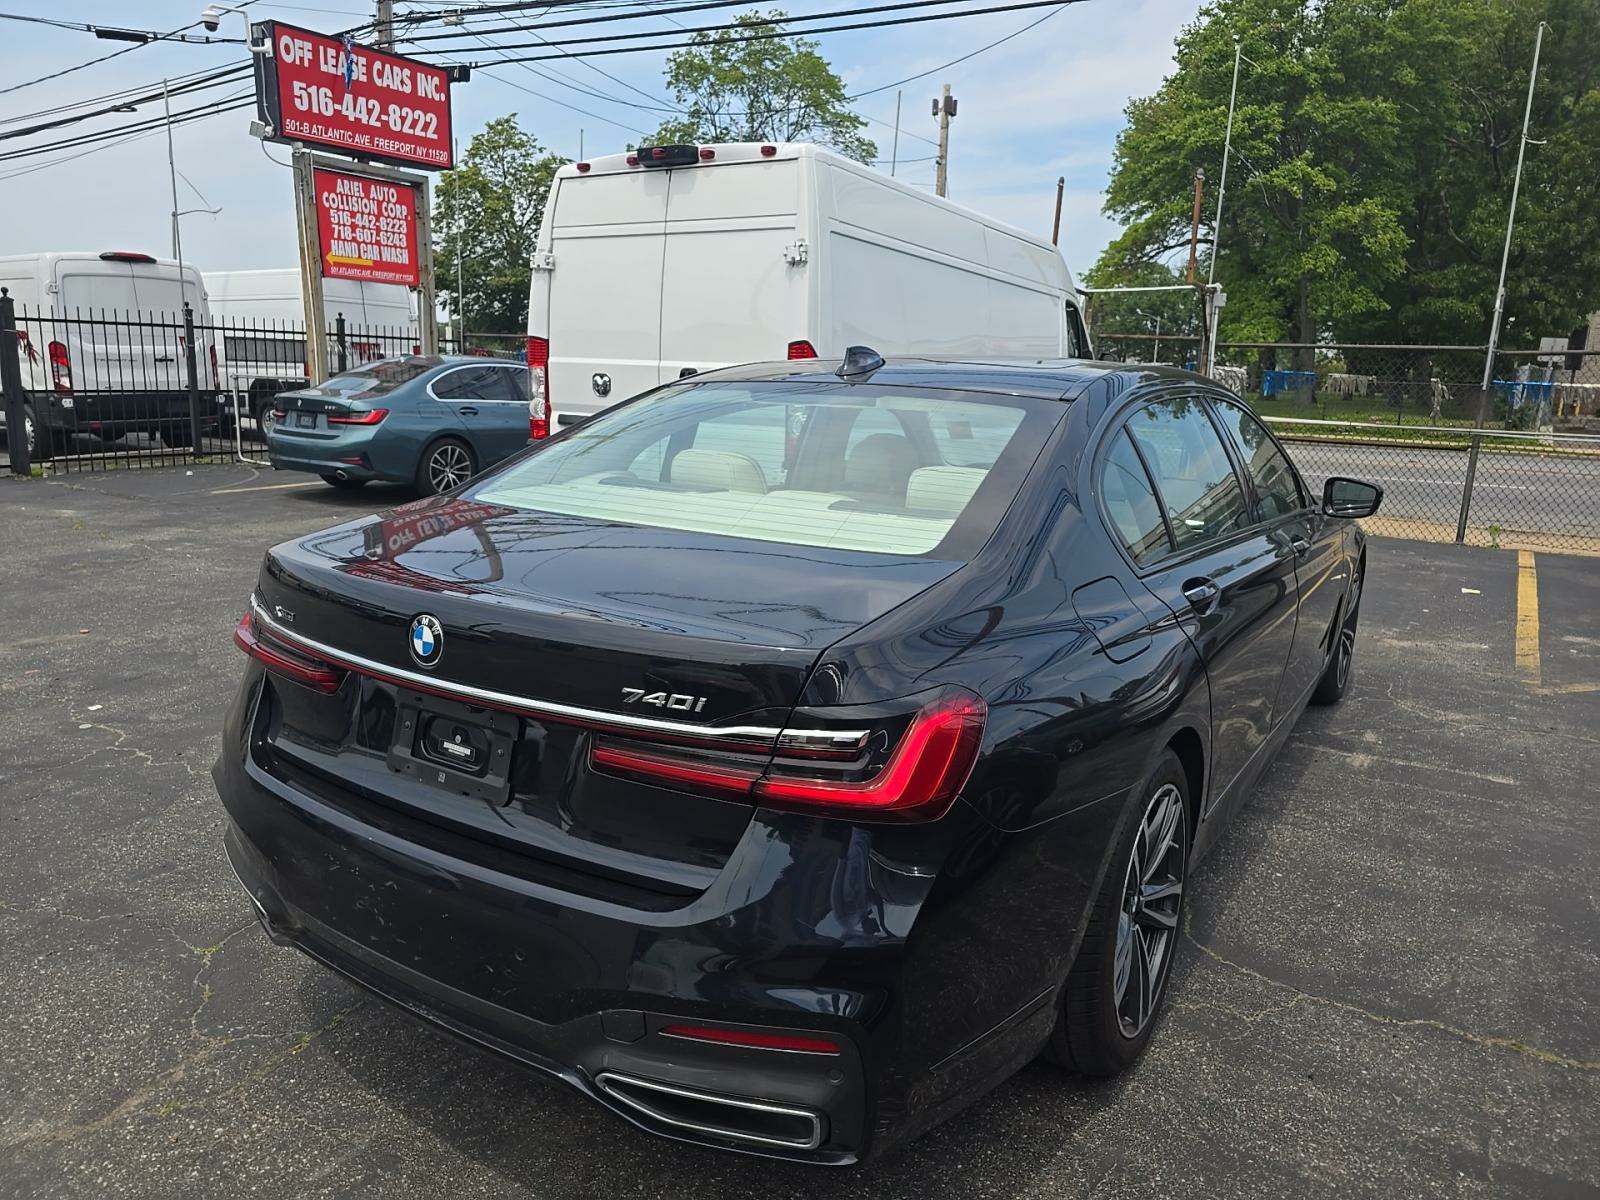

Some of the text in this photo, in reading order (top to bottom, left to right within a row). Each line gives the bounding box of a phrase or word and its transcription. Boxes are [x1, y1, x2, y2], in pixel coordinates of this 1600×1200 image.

[279, 34, 446, 102] OFF LEASE CARS INC.
[293, 80, 438, 139] 516-442-8222
[285, 119, 448, 161] 501-B ATLANTIC AVE. FREEPORT NY 11520
[336, 178, 397, 203] ARIEL AUTO
[322, 191, 411, 221] COLLISION CORP.
[330, 239, 409, 264] HAND CAR WASH
[621, 687, 707, 712] 740i
